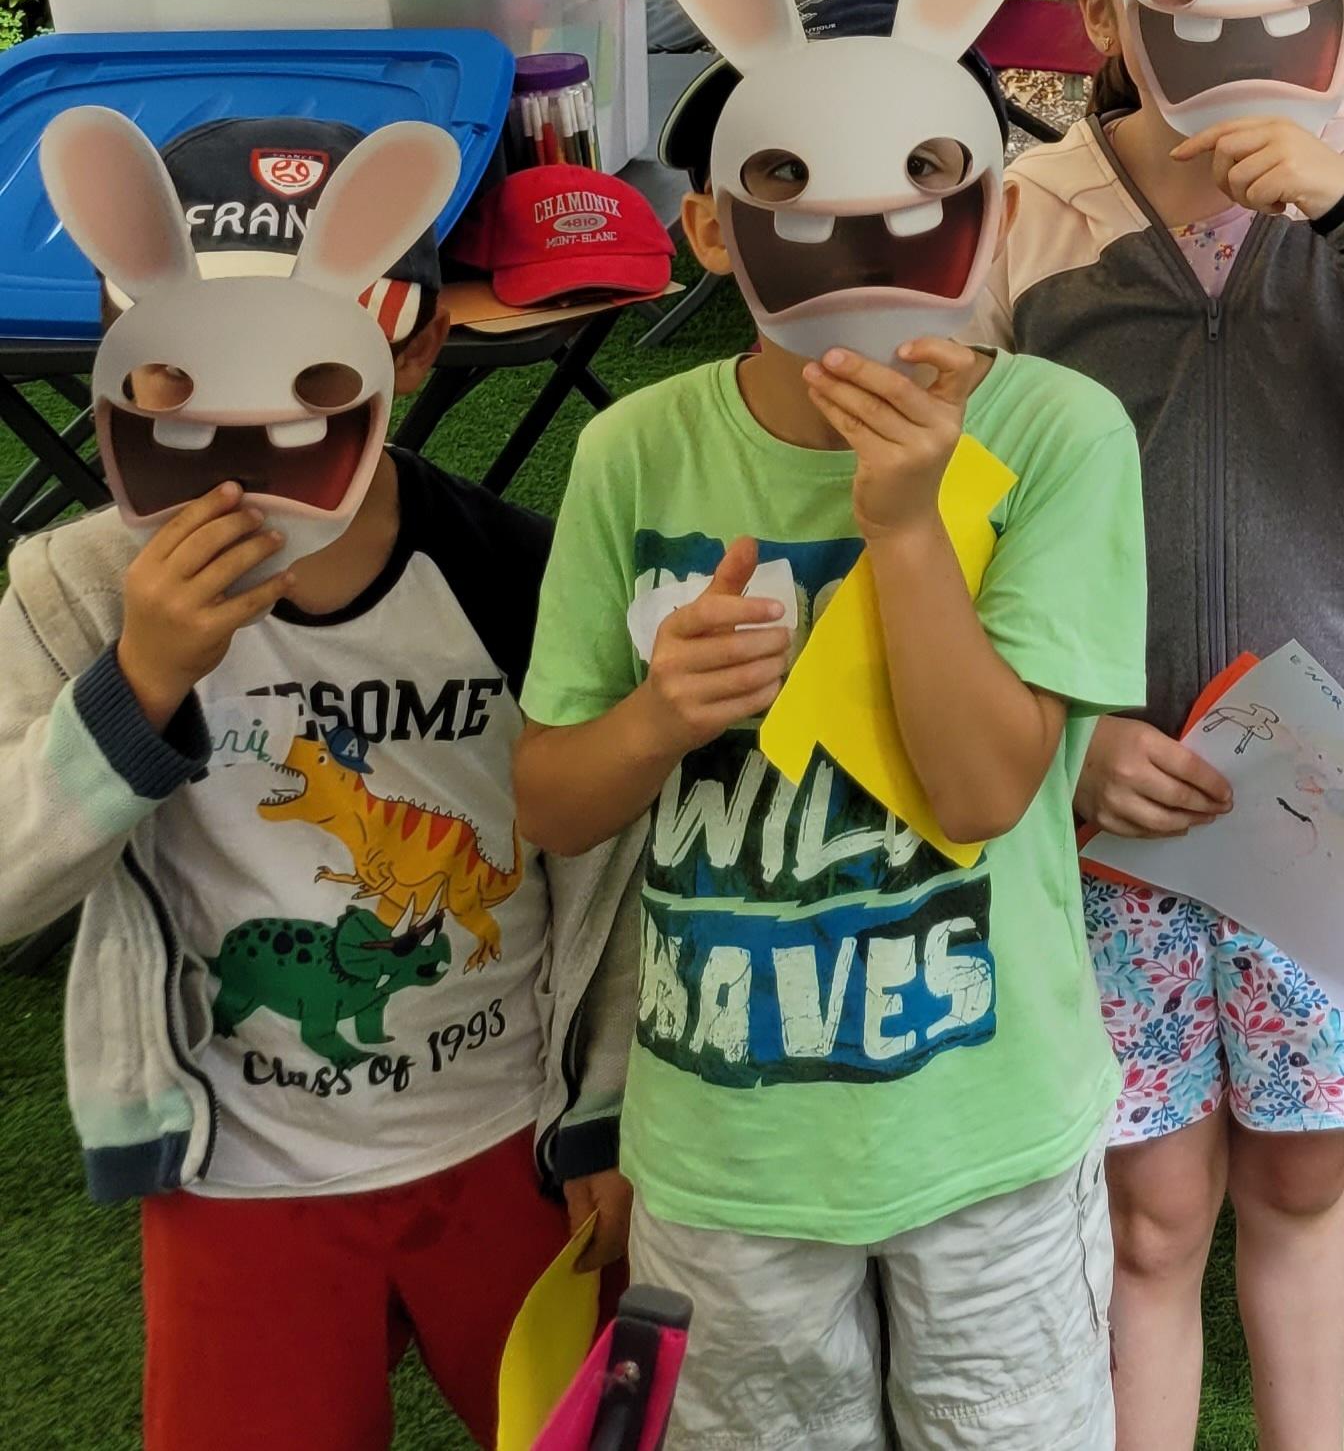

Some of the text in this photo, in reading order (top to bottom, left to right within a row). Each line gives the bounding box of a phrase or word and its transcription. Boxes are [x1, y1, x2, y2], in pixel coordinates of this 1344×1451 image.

[185, 201, 308, 239] FRAN
[534, 191, 622, 223] CHAMONIX
[561, 217, 598, 228] 4810
[545, 231, 617, 249] MONT-BLANC
[341, 738, 359, 757] A
[639, 911, 992, 1063] WAVES
[243, 1050, 353, 1098] Class
[426, 998, 506, 1072] 1993
